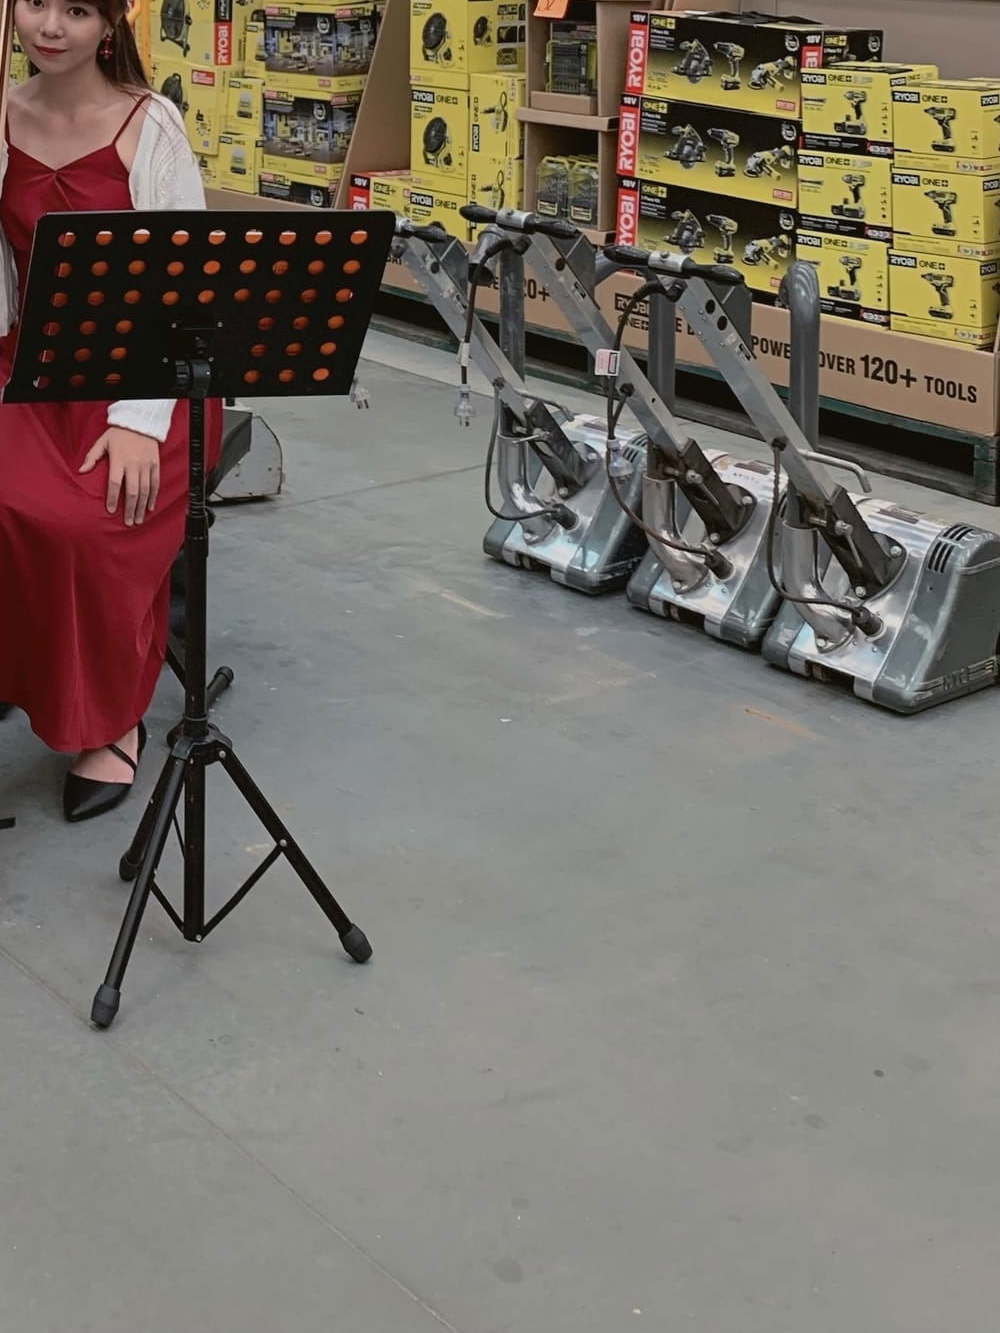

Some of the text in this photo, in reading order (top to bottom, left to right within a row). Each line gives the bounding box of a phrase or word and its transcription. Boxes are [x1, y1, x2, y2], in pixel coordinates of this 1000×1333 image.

[632, 14, 646, 23] 18V
[218, 25, 229, 64] RYOBI
[806, 35, 820, 44] 18V
[628, 30, 645, 88] RYOBI
[802, 74, 825, 83] RYOBI
[413, 91, 434, 101] RYOBI
[623, 96, 637, 105] 18V
[894, 92, 919, 101] RYOBI
[982, 96, 999, 105] RYOBI
[620, 113, 635, 171] RYOBI
[799, 156, 823, 165] RYOBI
[354, 178, 368, 186] 18V
[622, 179, 636, 188] 18V
[893, 174, 919, 185] RYOBI
[983, 180, 999, 190] RYOBI
[411, 194, 432, 206] RYOBI
[797, 236, 820, 246] RYOBI
[891, 256, 916, 267] RYOBI
[860, 354, 917, 388] 120+
[924, 375, 977, 403] TOOLS
